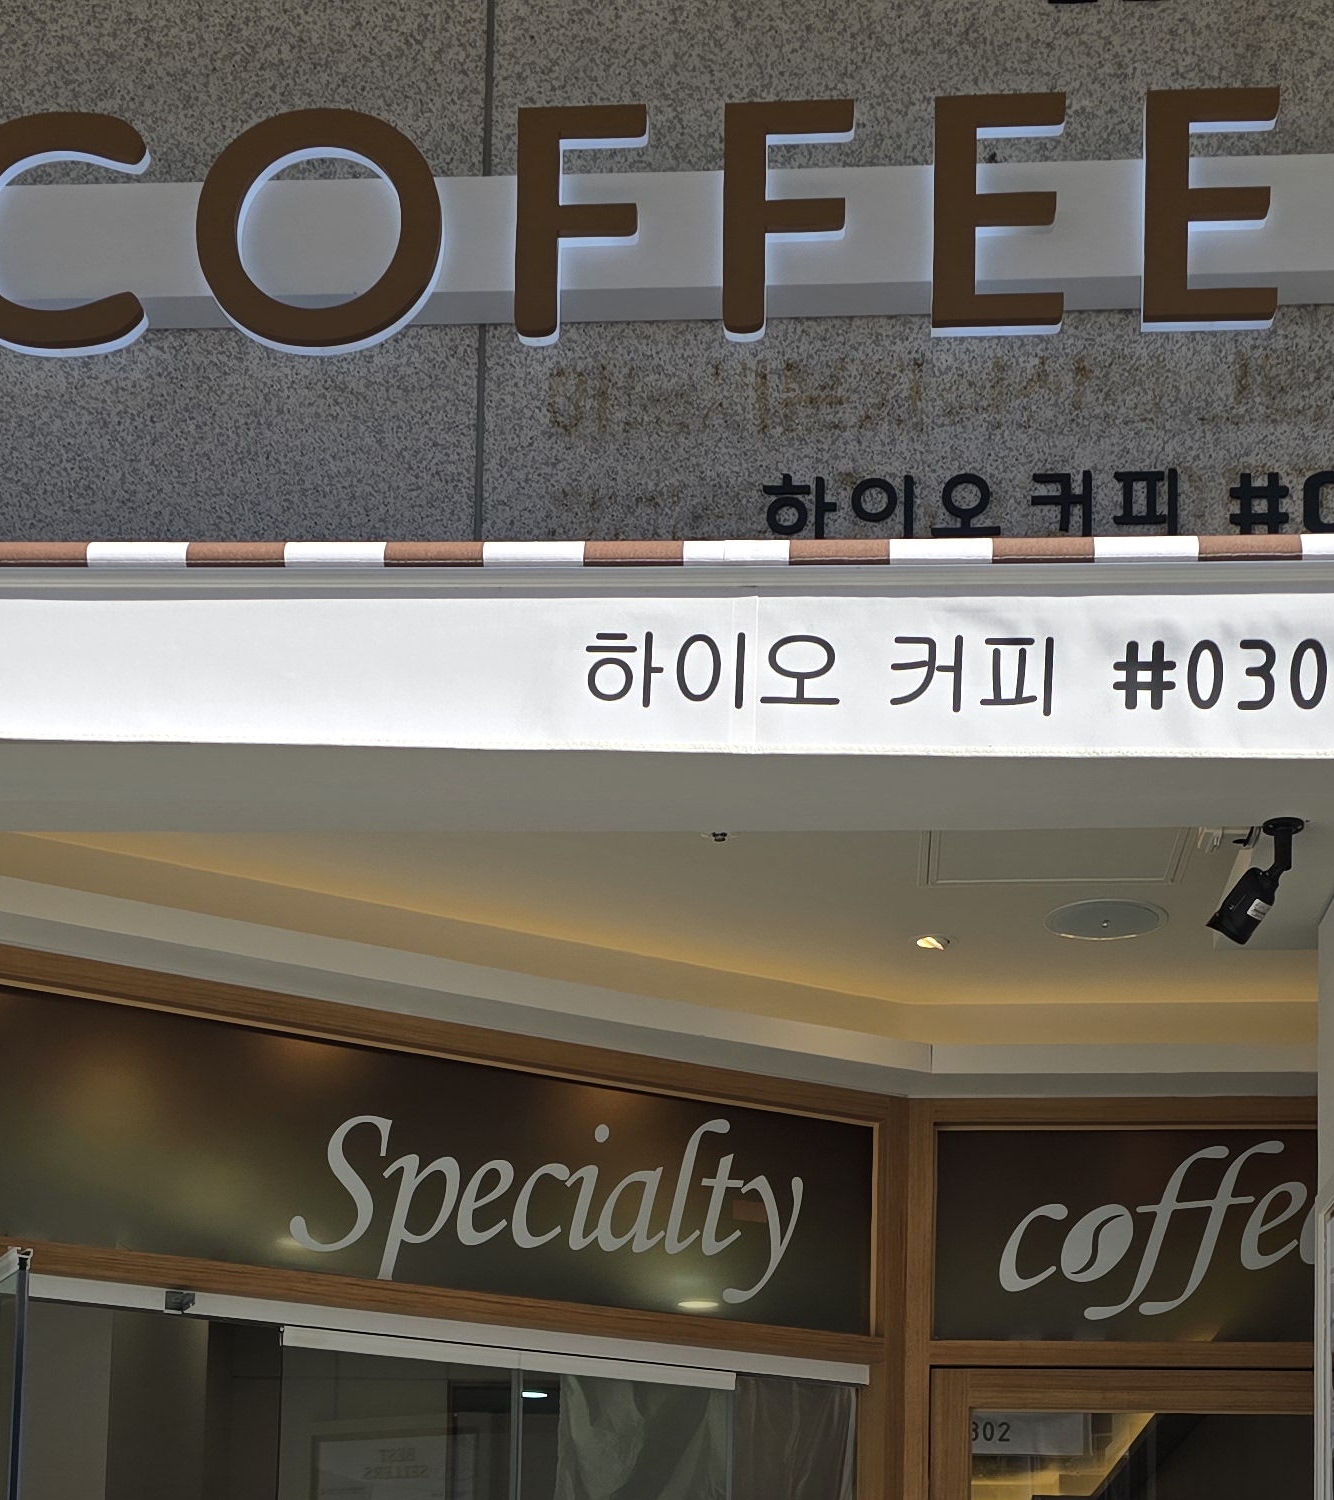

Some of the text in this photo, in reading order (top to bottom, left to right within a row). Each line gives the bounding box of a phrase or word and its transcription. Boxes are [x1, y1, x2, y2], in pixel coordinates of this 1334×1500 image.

[762, 472, 1001, 539] 하이오
[1032, 467, 1181, 535] 커피
[585, 632, 842, 710] 하이오
[889, 635, 1058, 718] 커피
[289, 1114, 805, 1305] Specialty
